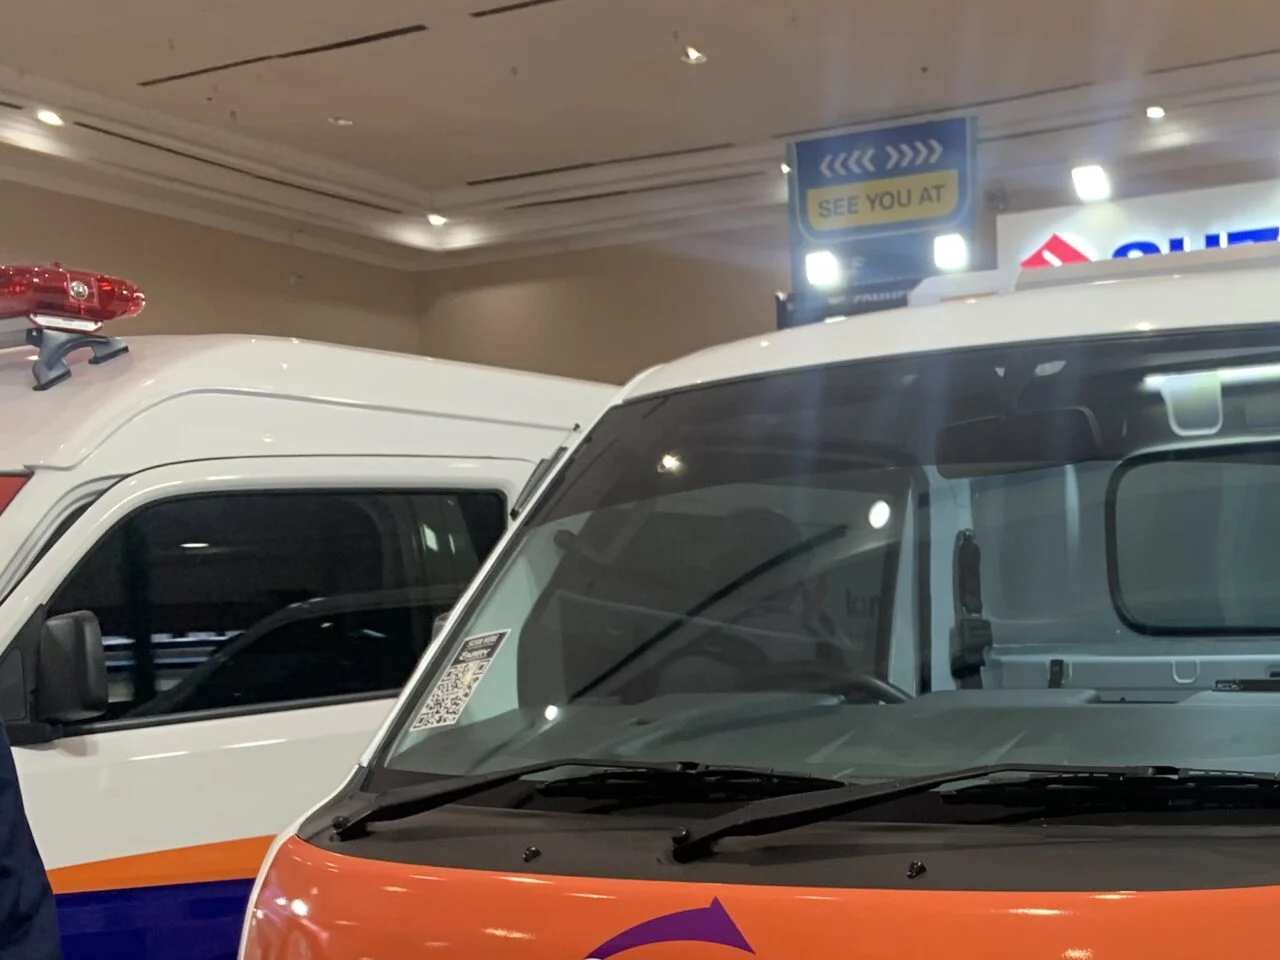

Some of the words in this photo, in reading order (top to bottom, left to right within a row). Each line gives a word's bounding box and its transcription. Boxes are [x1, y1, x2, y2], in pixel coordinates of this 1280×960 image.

[818, 196, 860, 218] SEE
[866, 189, 912, 212] YOU
[919, 184, 946, 205] AT
